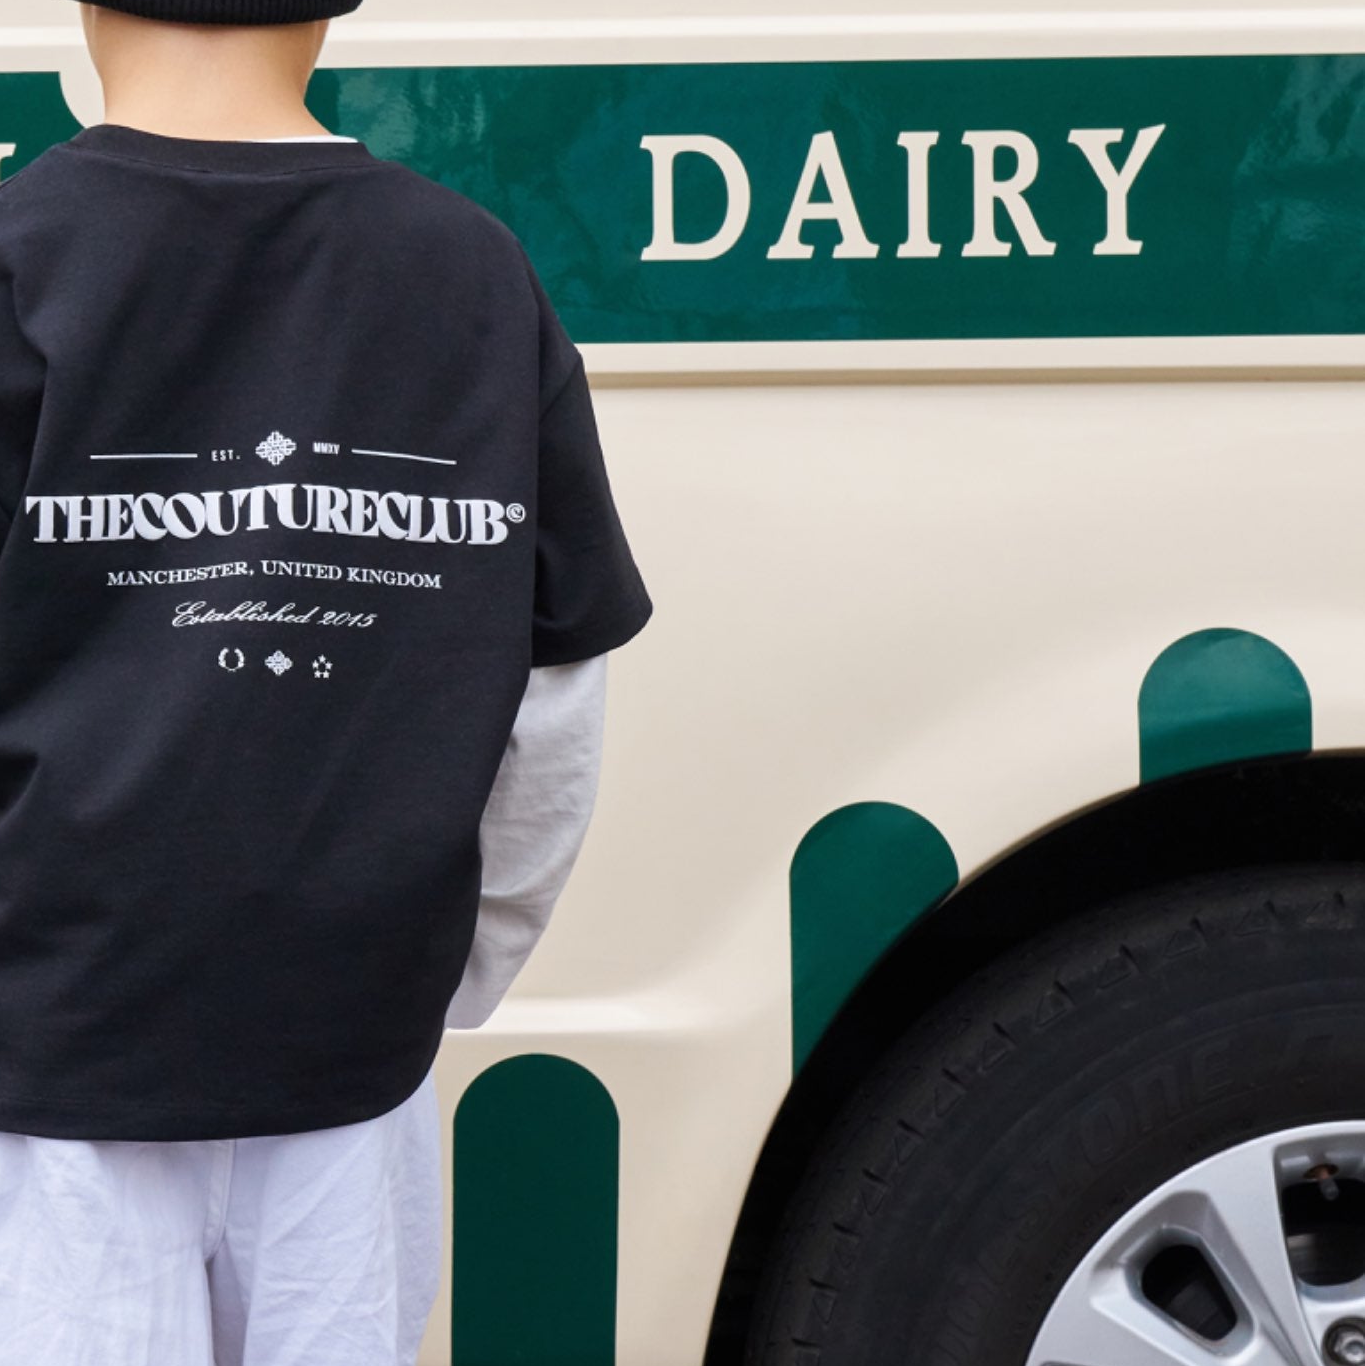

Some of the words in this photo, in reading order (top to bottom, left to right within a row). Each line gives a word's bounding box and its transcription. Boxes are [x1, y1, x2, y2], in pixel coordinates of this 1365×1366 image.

[639, 123, 1167, 262] DAIRY
[211, 449, 241, 462] EST.
[106, 560, 255, 587] MANCHESTER,
[259, 559, 343, 581] UNITED
[346, 566, 443, 590] KINGDOM
[171, 600, 320, 628] Established
[320, 610, 379, 628] 2015
